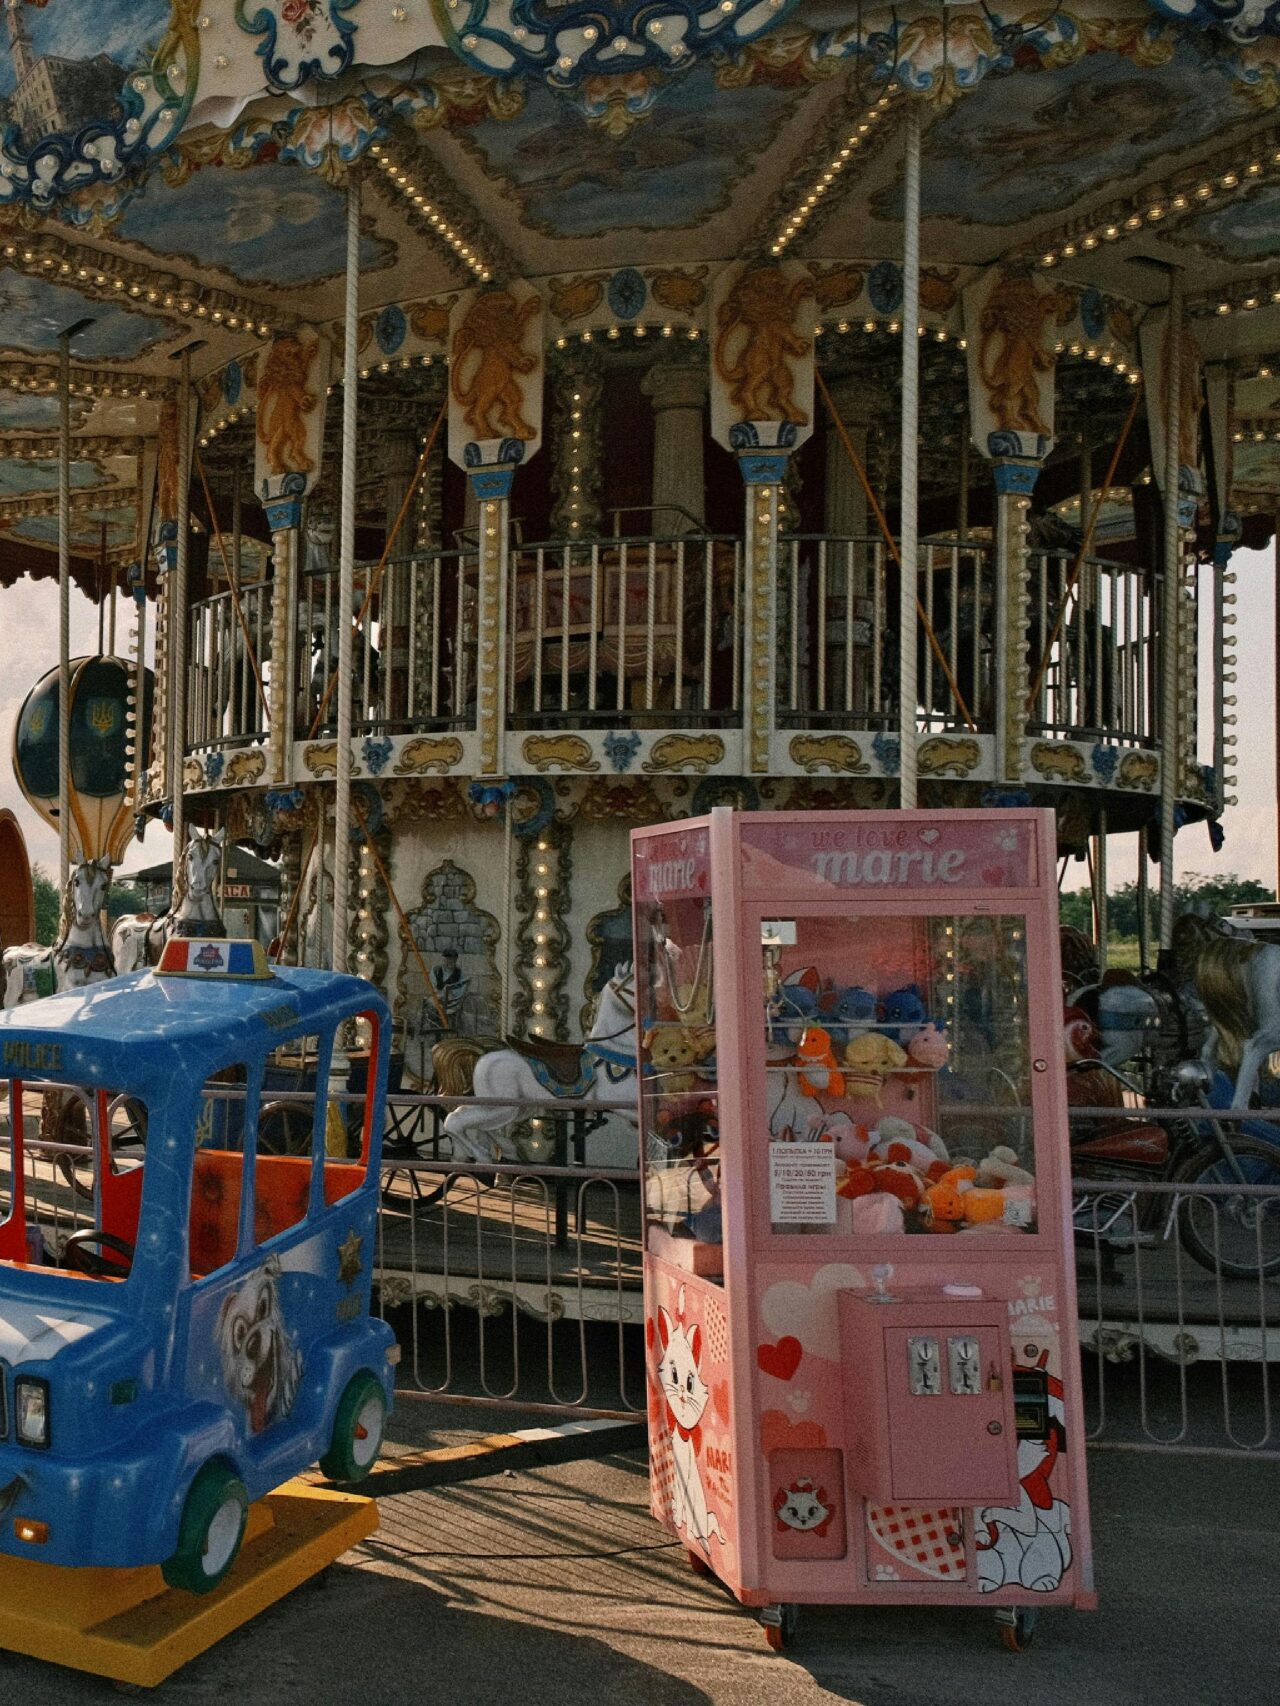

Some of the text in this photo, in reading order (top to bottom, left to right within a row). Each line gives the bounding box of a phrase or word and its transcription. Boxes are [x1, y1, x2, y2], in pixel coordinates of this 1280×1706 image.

[811, 826, 911, 849] we love
[648, 859, 695, 893] marie
[813, 847, 968, 886] marie
[222, 885, 249, 897] АСА
